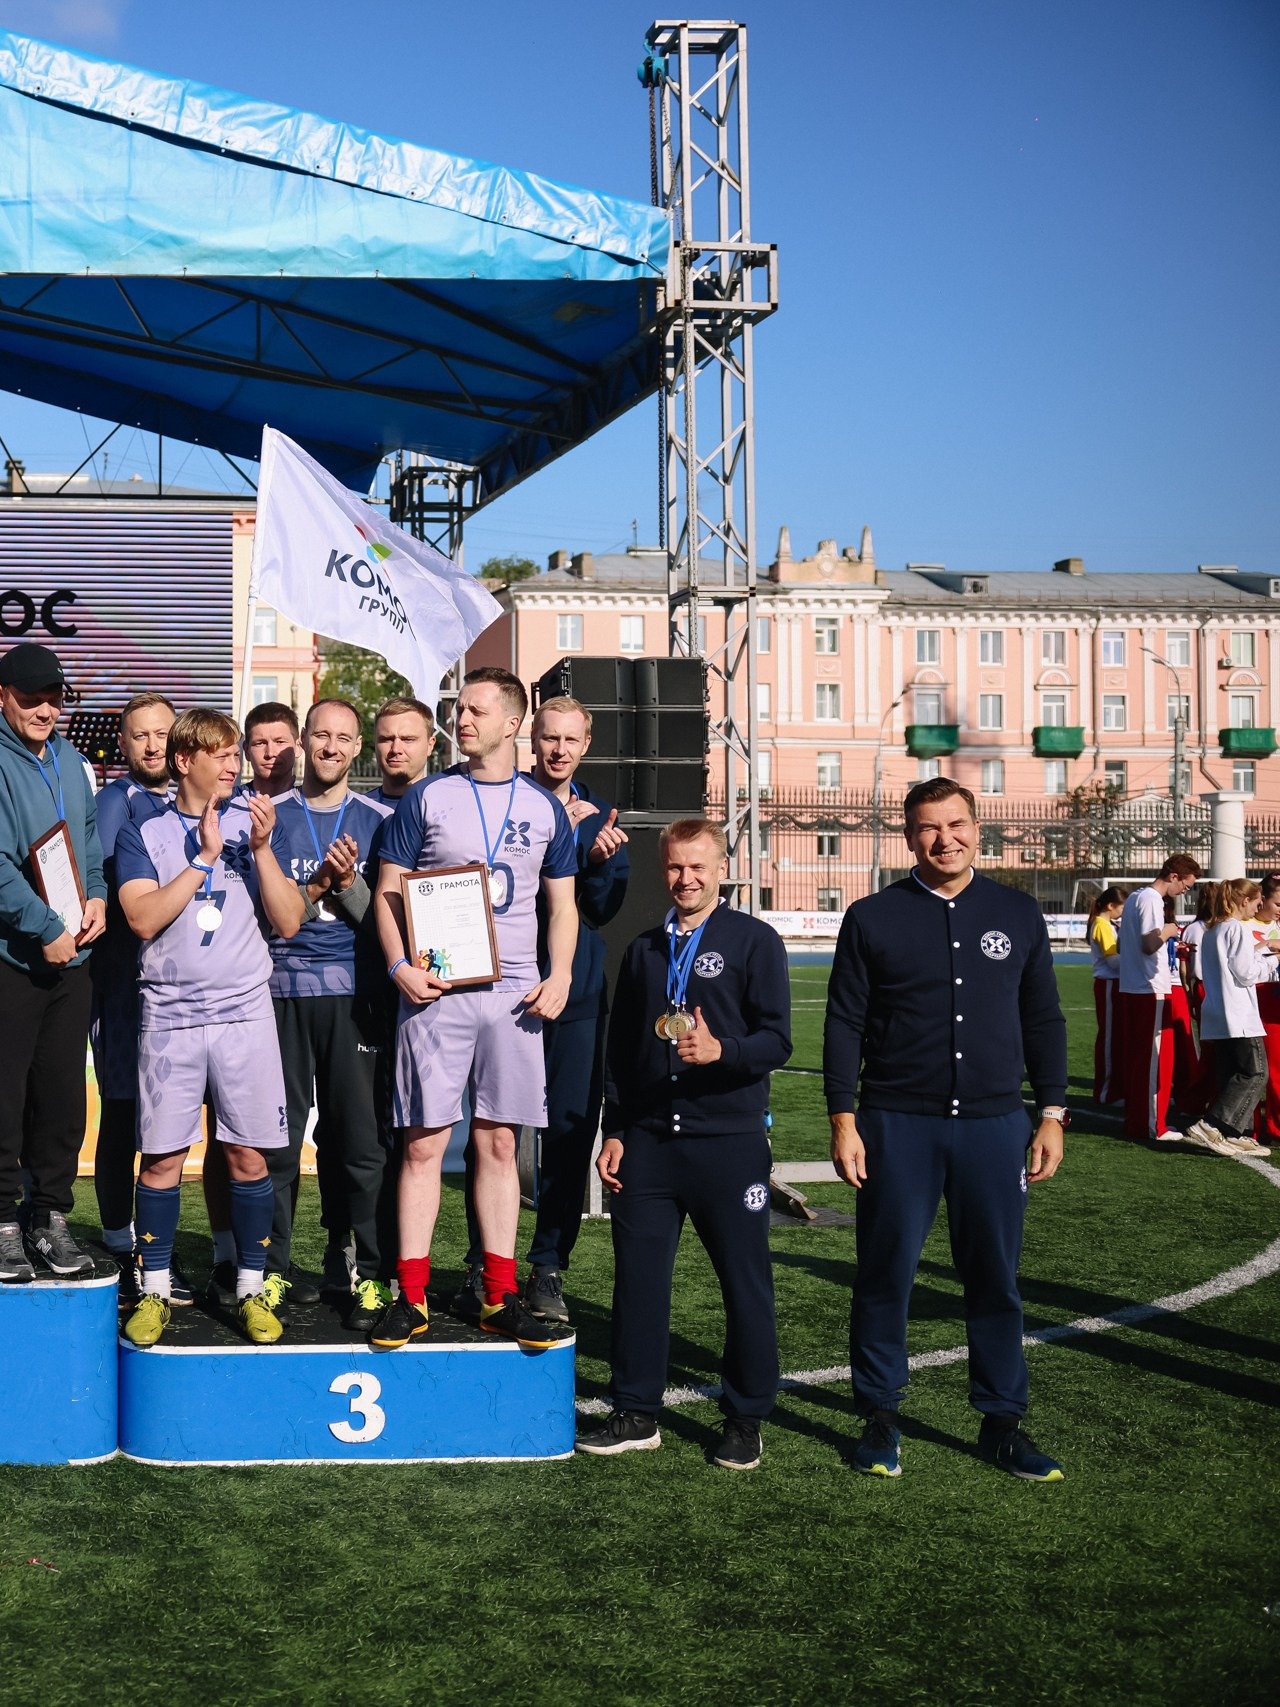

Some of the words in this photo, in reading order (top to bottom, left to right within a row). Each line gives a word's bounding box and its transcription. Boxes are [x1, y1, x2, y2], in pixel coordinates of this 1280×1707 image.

[324, 549, 417, 641] КОМО
[358, 595, 405, 634] ГРУПП
[504, 846, 531, 855] КОМОС
[224, 871, 251, 880] КОМОС
[440, 879, 480, 890] ГРАМОТА
[328, 1372, 386, 1443] 3
